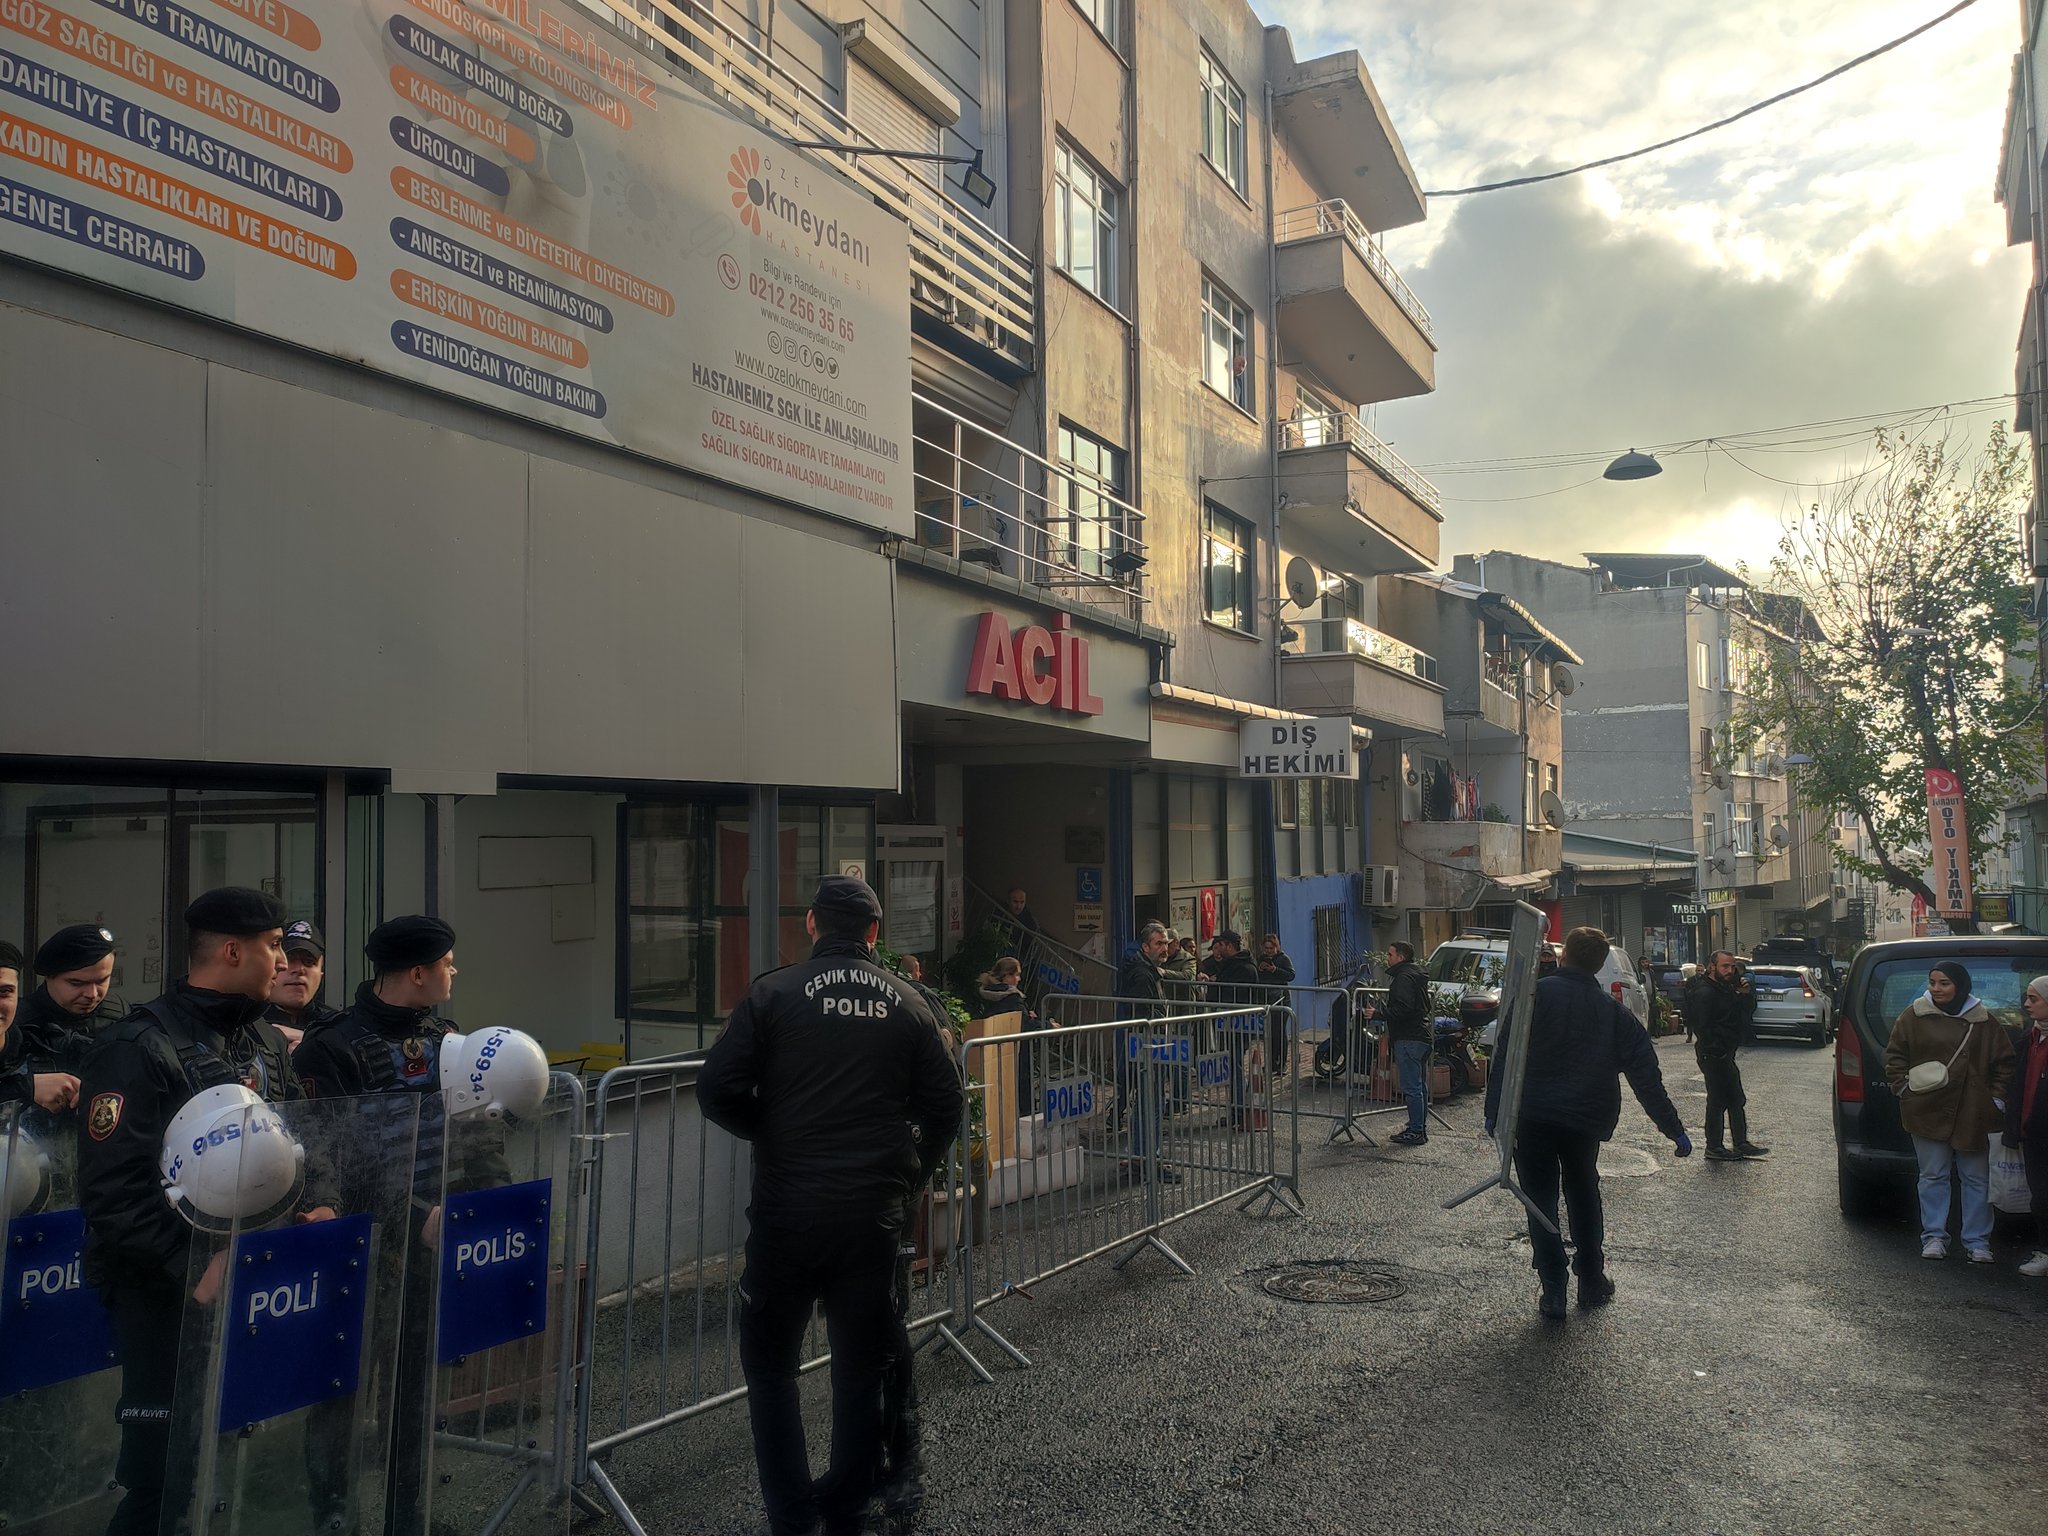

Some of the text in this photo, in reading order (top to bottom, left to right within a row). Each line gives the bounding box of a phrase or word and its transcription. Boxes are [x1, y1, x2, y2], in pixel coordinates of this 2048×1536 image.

[1, 0, 339, 164] GÖZ SAĞLIĞI ve HASTALIKLARI
[133, 0, 323, 104] ve TRAVMATOLOJİ
[410, 27, 460, 74] KULAK
[464, 61, 515, 104] BURUN
[519, 89, 564, 132] BOĞAZ
[510, 41, 525, 64] ve
[529, 53, 618, 119] KOLONOSKOPİ
[0, 56, 114, 125] DAHİLİYE
[139, 108, 161, 150] İÇ
[170, 125, 318, 208] HASTALIKLARI
[410, 76, 507, 146] KARDİYOLOJİ
[410, 123, 476, 178] ÜROLOJİ
[763, 156, 812, 196] ÖZEL
[0, 184, 190, 274] GENEL CERRAHİ
[77, 149, 229, 230] HASTALIKLARI
[236, 211, 261, 242] VE
[268, 224, 336, 270] DOĞUM
[410, 177, 492, 233] BESLENME
[496, 221, 512, 242] ve
[516, 227, 582, 275] DİYETETİK
[594, 263, 662, 310] DİYETİSYEN
[410, 228, 483, 277] ANESTEZİ
[488, 264, 504, 286] ve
[508, 270, 603, 328] REANİMASYON
[749, 272, 855, 343] 0212 256 35 65
[763, 258, 842, 310] Bilgi ve Randevu için
[411, 277, 473, 321] ERİŞKİN
[477, 304, 527, 343] YOĞUN
[531, 325, 573, 360] BAKIM
[411, 328, 500, 379] YENİDOĞAN
[504, 361, 552, 397] YOĞUN
[556, 381, 596, 412] BAKIM
[734, 350, 868, 418] www.ozelokmeydani.com
[692, 362, 899, 461] HASTANEMİZ SGK İLE ANLAŞMALIDIR
[711, 406, 886, 486] ÖZEL SAĞLIK SİGORTA VE TAMAMLAYICI
[701, 433, 894, 511] SAĞLIK SİGORTA ANLAŞMALARIMIZ VARDIR
[966, 611, 1104, 716] ACİL
[1245, 750, 1344, 774] HEKİMİ
[1272, 722, 1317, 748] DİŞ
[1672, 905, 1707, 915] TABELA
[804, 968, 902, 1008] ÇEVİK KUVVET
[823, 997, 888, 1019] POLİS
[1039, 960, 1081, 994] POLİS
[1047, 1082, 1092, 1120] POLİS
[456, 1228, 525, 1271] POLİS
[140, 1408, 170, 1419] KUVVET
